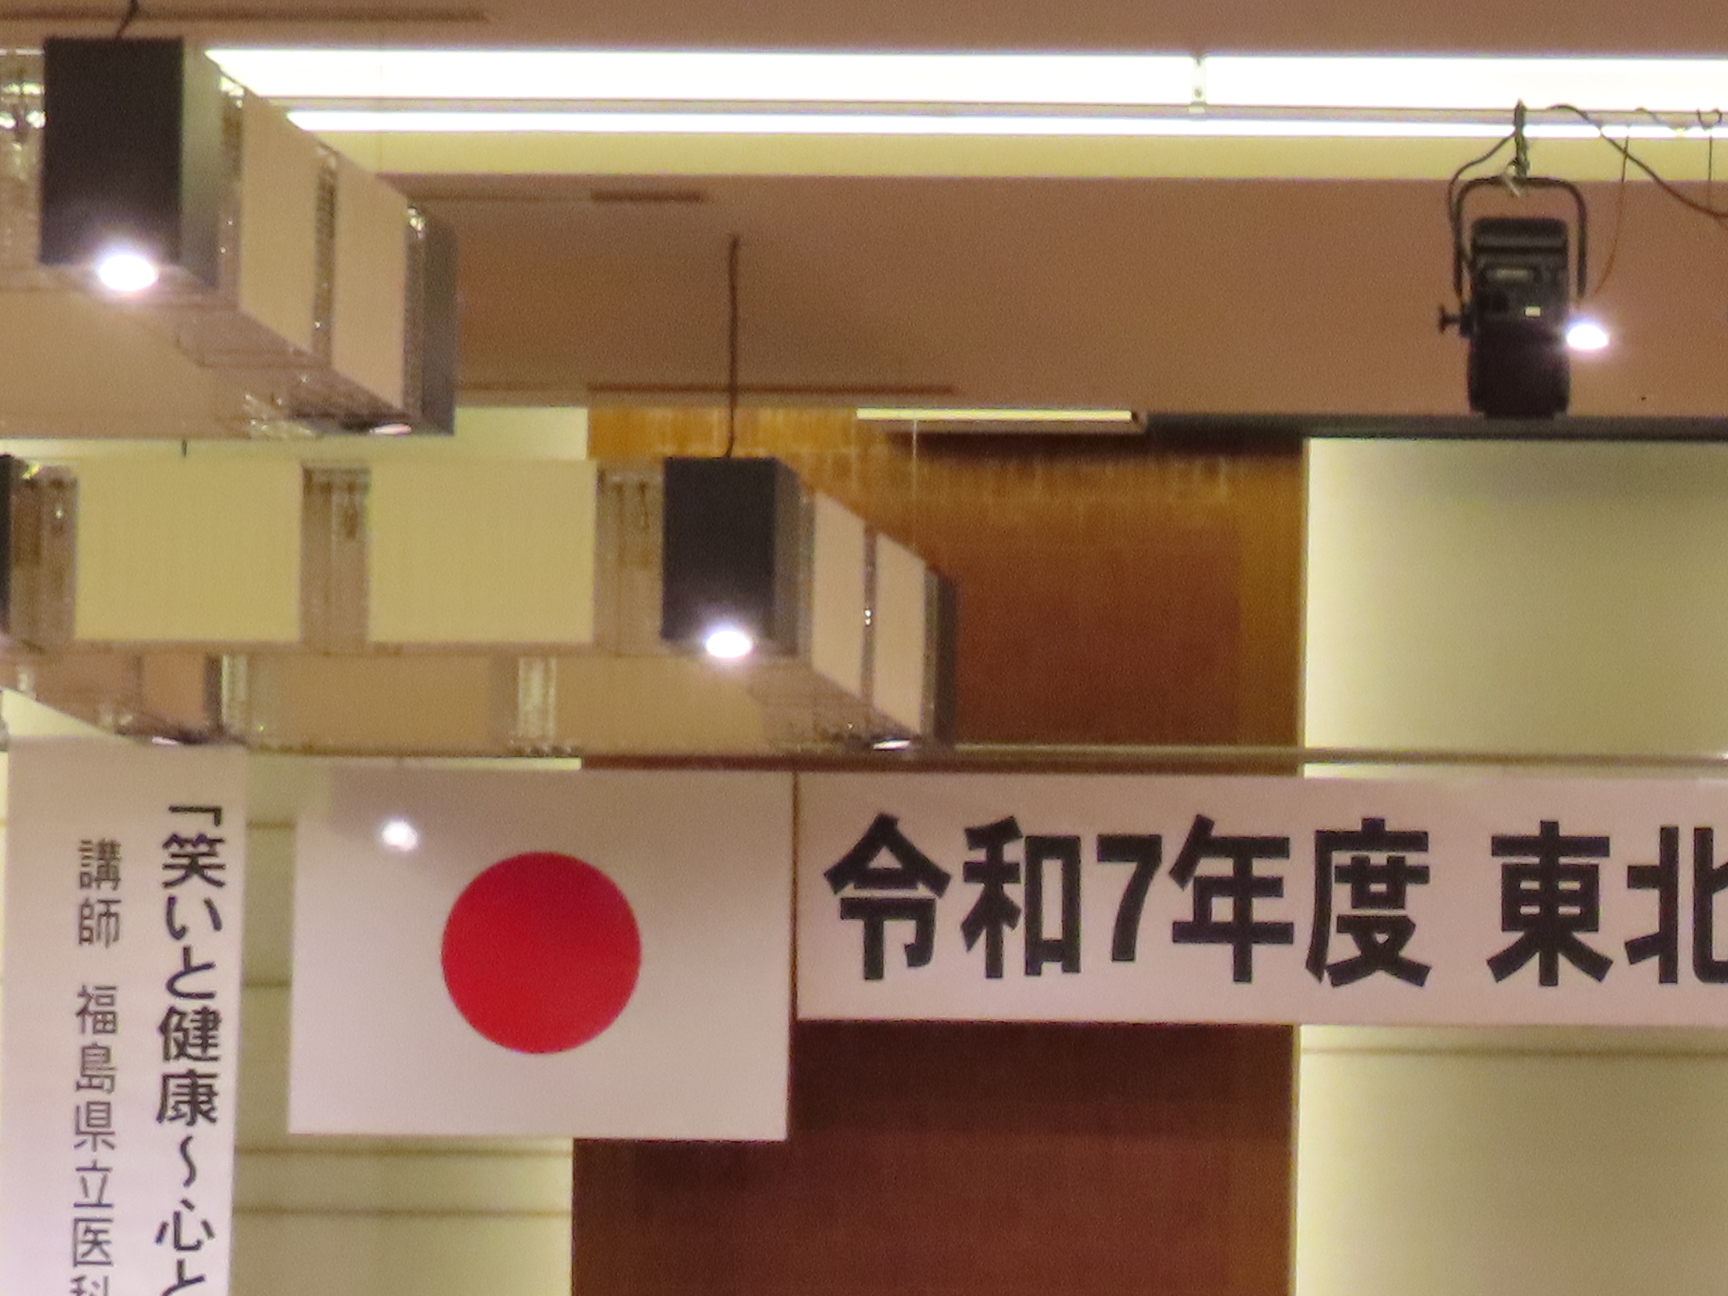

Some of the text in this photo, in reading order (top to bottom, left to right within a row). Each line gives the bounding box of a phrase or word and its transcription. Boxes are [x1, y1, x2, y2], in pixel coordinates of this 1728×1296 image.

[77, 838, 122, 949] 講師
[823, 812, 1433, 989] 令和7年度
